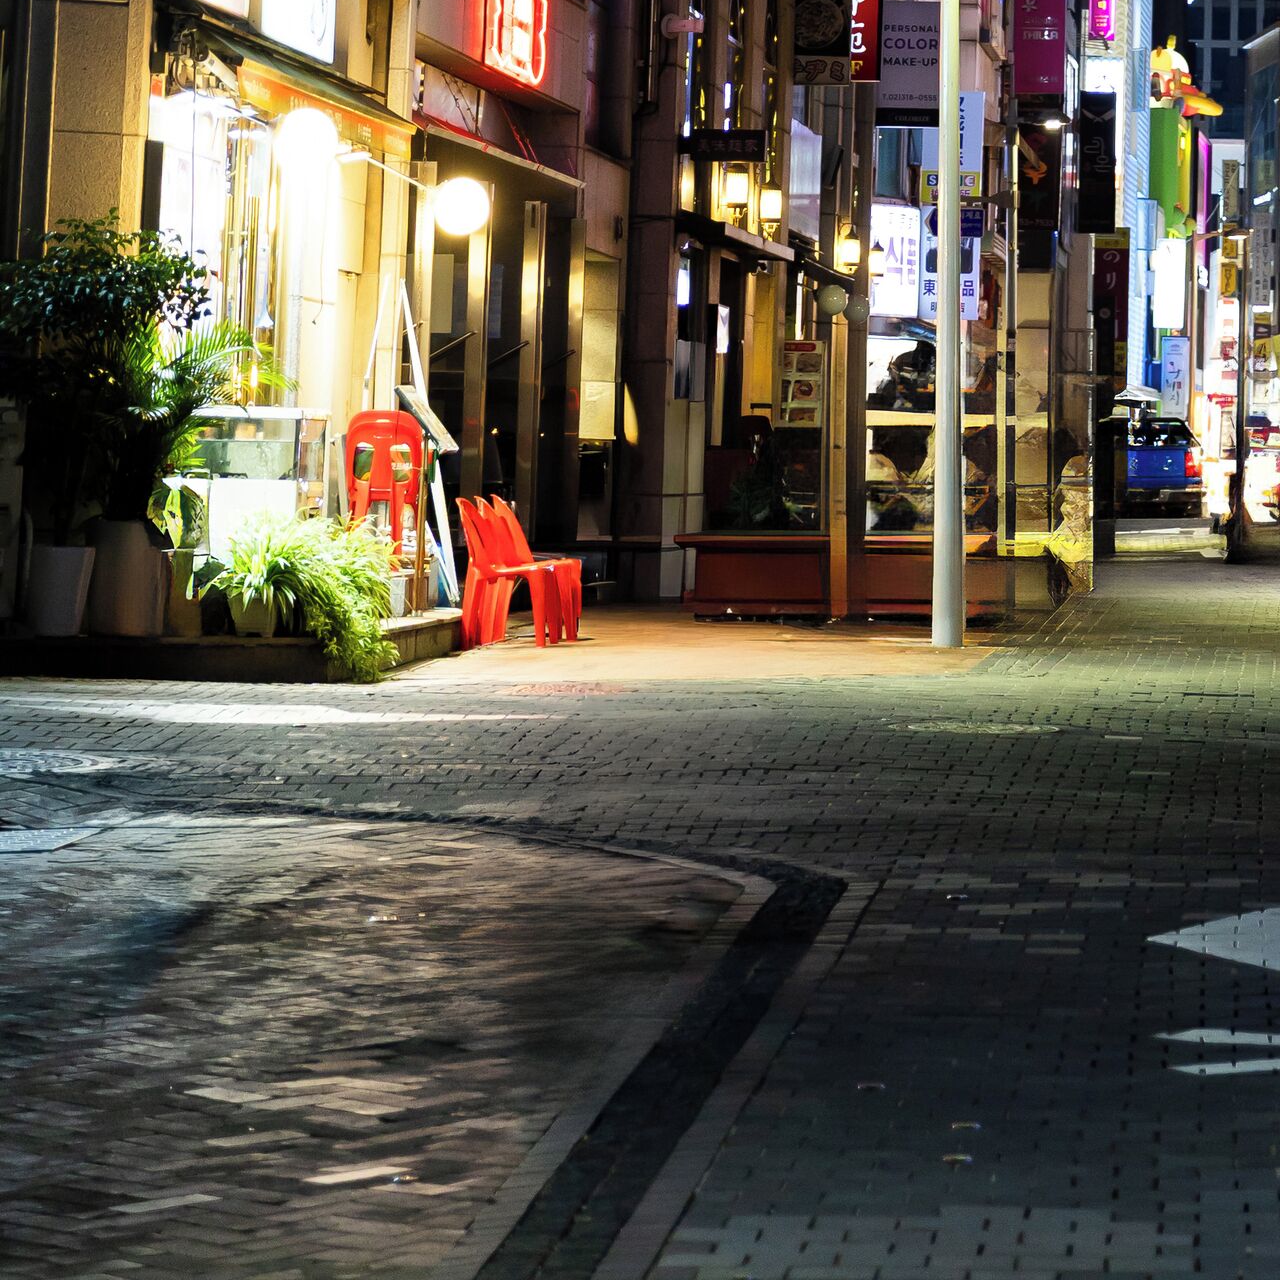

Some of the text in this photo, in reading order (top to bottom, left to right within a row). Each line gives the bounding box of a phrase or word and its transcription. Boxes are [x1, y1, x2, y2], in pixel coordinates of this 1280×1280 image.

[884, 24, 939, 33] PERSONAL
[883, 37, 938, 50] COLOR
[883, 57, 938, 67] MAKE-UP
